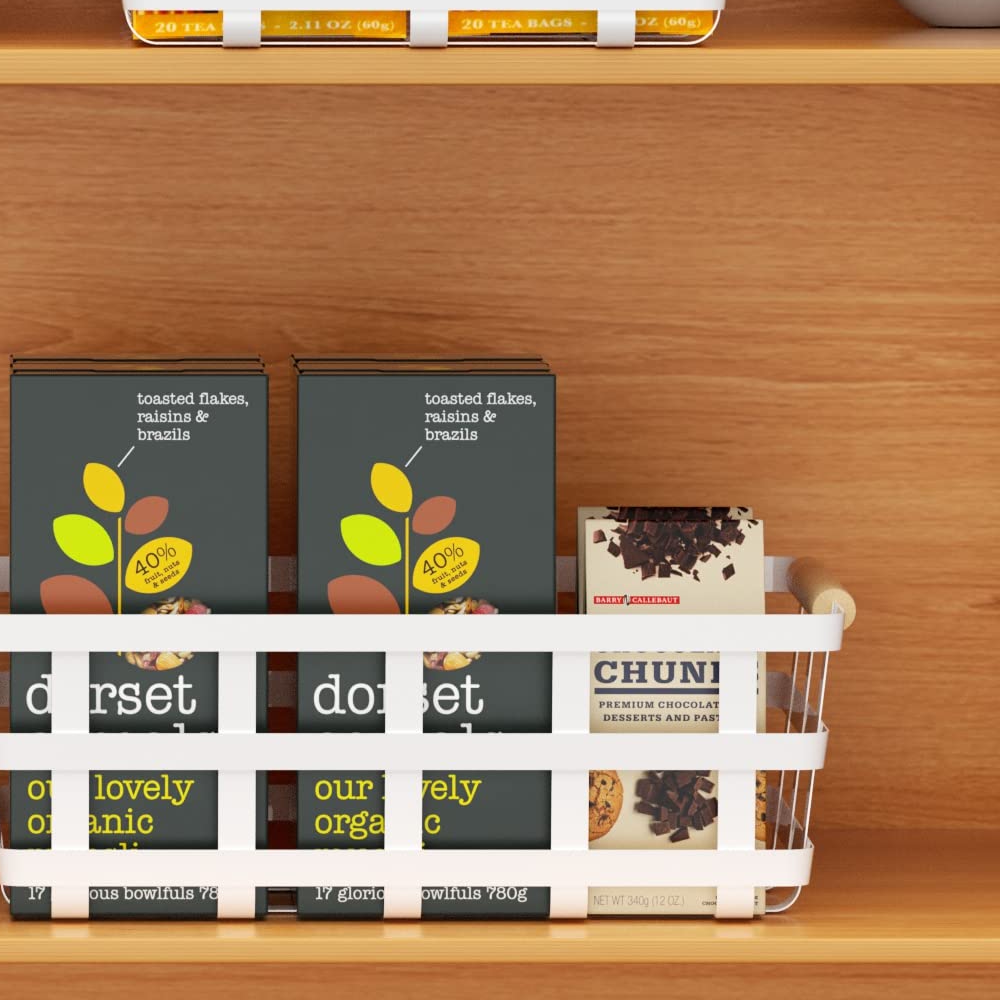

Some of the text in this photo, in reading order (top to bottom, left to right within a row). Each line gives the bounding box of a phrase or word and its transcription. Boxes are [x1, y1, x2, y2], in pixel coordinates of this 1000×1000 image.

[155, 21, 176, 33] 20
[182, 21, 216, 32] TEA
[288, 20, 321, 30] 2.11
[326, 19, 351, 30] OZ
[356, 19, 396, 32] (60g)
[461, 17, 483, 30] 20
[489, 18, 523, 29] TEA
[527, 17, 573, 29] BAGS
[662, 15, 702, 29] (60g)
[137, 391, 249, 408] toasted flakes,
[424, 391, 536, 408] toasted flakes,
[136, 409, 209, 424] raisins &
[424, 409, 496, 424] raisins &
[137, 427, 191, 442] brazils
[424, 427, 478, 442] brazils
[136, 542, 177, 576] 40%
[163, 559, 180, 573] nuts
[424, 542, 464, 576] 40%
[450, 559, 468, 573] nuts
[159, 569, 180, 584] seeds
[446, 569, 468, 584] seeds
[595, 596, 679, 604] BARRY CALLEBAUT
[594, 660, 720, 684] CHUN
[25, 673, 197, 716] drset
[313, 673, 485, 716] doet
[599, 701, 720, 709] PREMIUM CHOCOLAT
[603, 714, 662, 722] DESSERTS
[665, 714, 691, 722] AND
[94, 774, 195, 806] lovely
[314, 779, 374, 801] our
[27, 807, 154, 835] oanic
[314, 810, 442, 840] orgac
[27, 886, 46, 901] 17
[122, 886, 195, 901] bowlfuls
[198, 886, 219, 901] 78
[314, 886, 528, 903] 17 glorio owlfuls 780g
[593, 895, 609, 906] NET
[611, 895, 625, 906] WT
[627, 895, 649, 908] 340g
